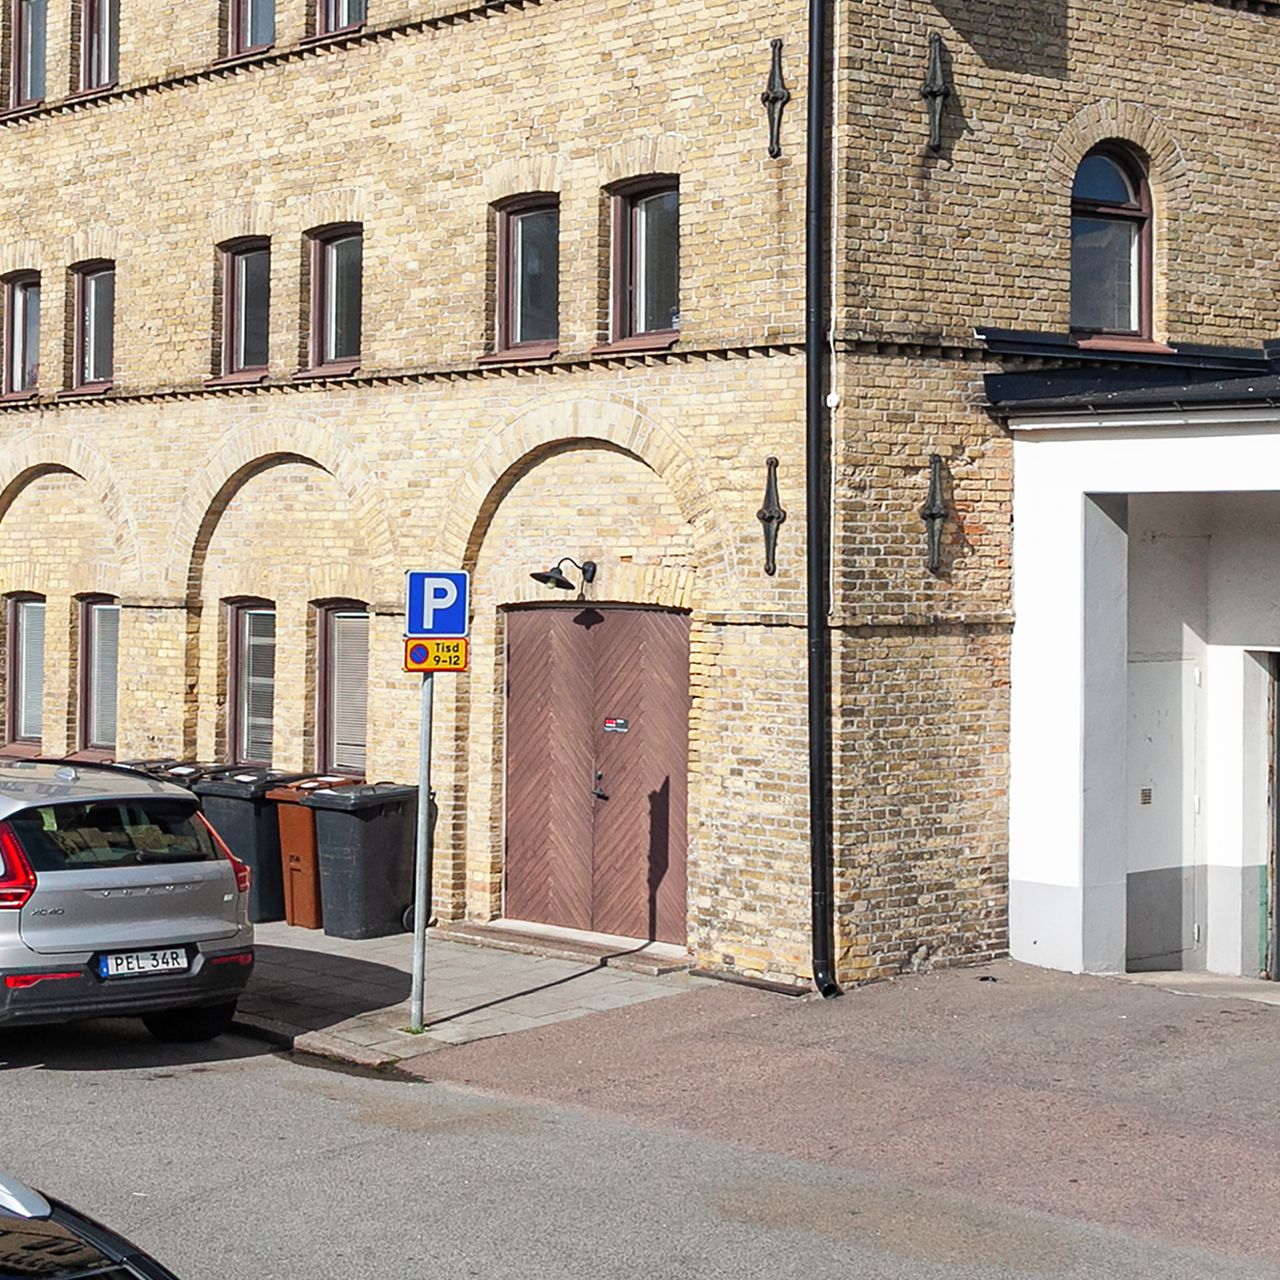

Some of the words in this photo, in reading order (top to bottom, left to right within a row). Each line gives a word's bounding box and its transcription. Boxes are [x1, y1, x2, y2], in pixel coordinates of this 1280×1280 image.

[423, 577, 458, 630] P
[435, 643, 460, 652] Tisd
[433, 655, 460, 665] 9-12
[114, 954, 145, 972] PEL
[149, 951, 181, 968] 34R
